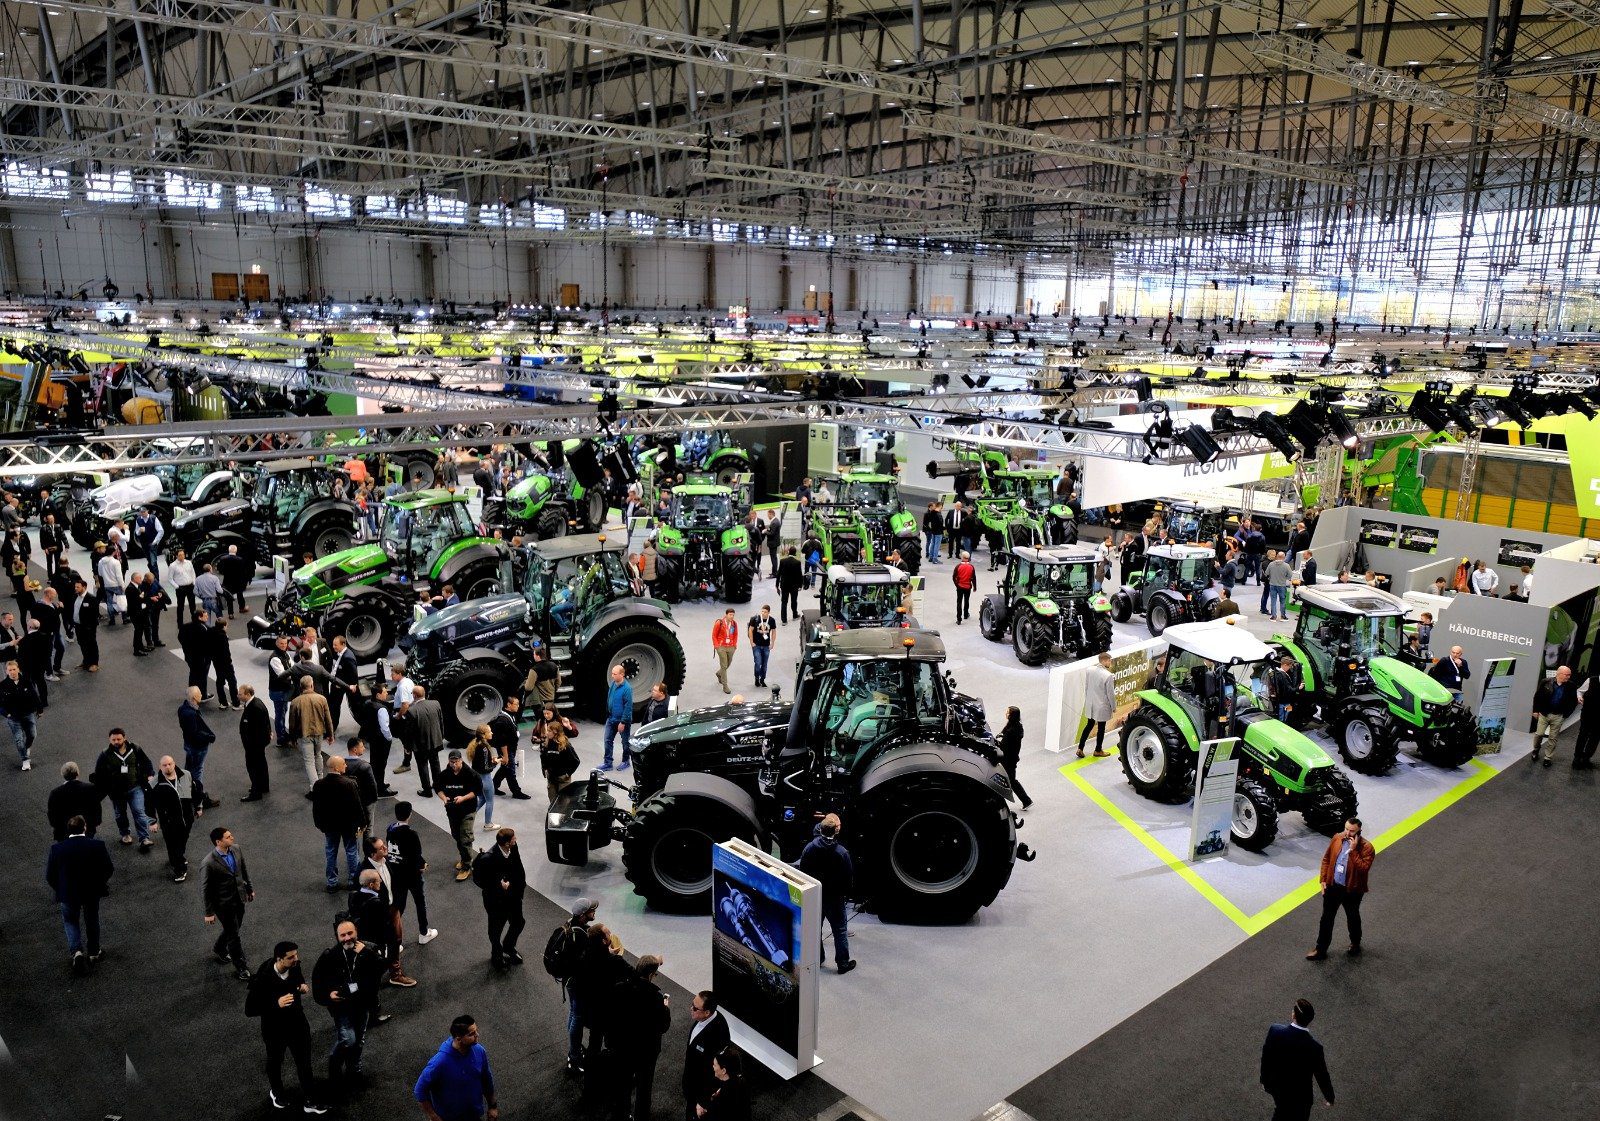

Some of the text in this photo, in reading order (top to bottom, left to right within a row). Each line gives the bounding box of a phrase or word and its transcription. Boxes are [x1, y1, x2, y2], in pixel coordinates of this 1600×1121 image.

[753, 322, 785, 331] OLLAND
[1183, 457, 1238, 477] REGION
[474, 626, 510, 640] DEUTZ-FAHR
[1448, 623, 1534, 647] HÄNDLERBEREICH
[1112, 659, 1150, 681] ernational
[1113, 680, 1137, 696] egion
